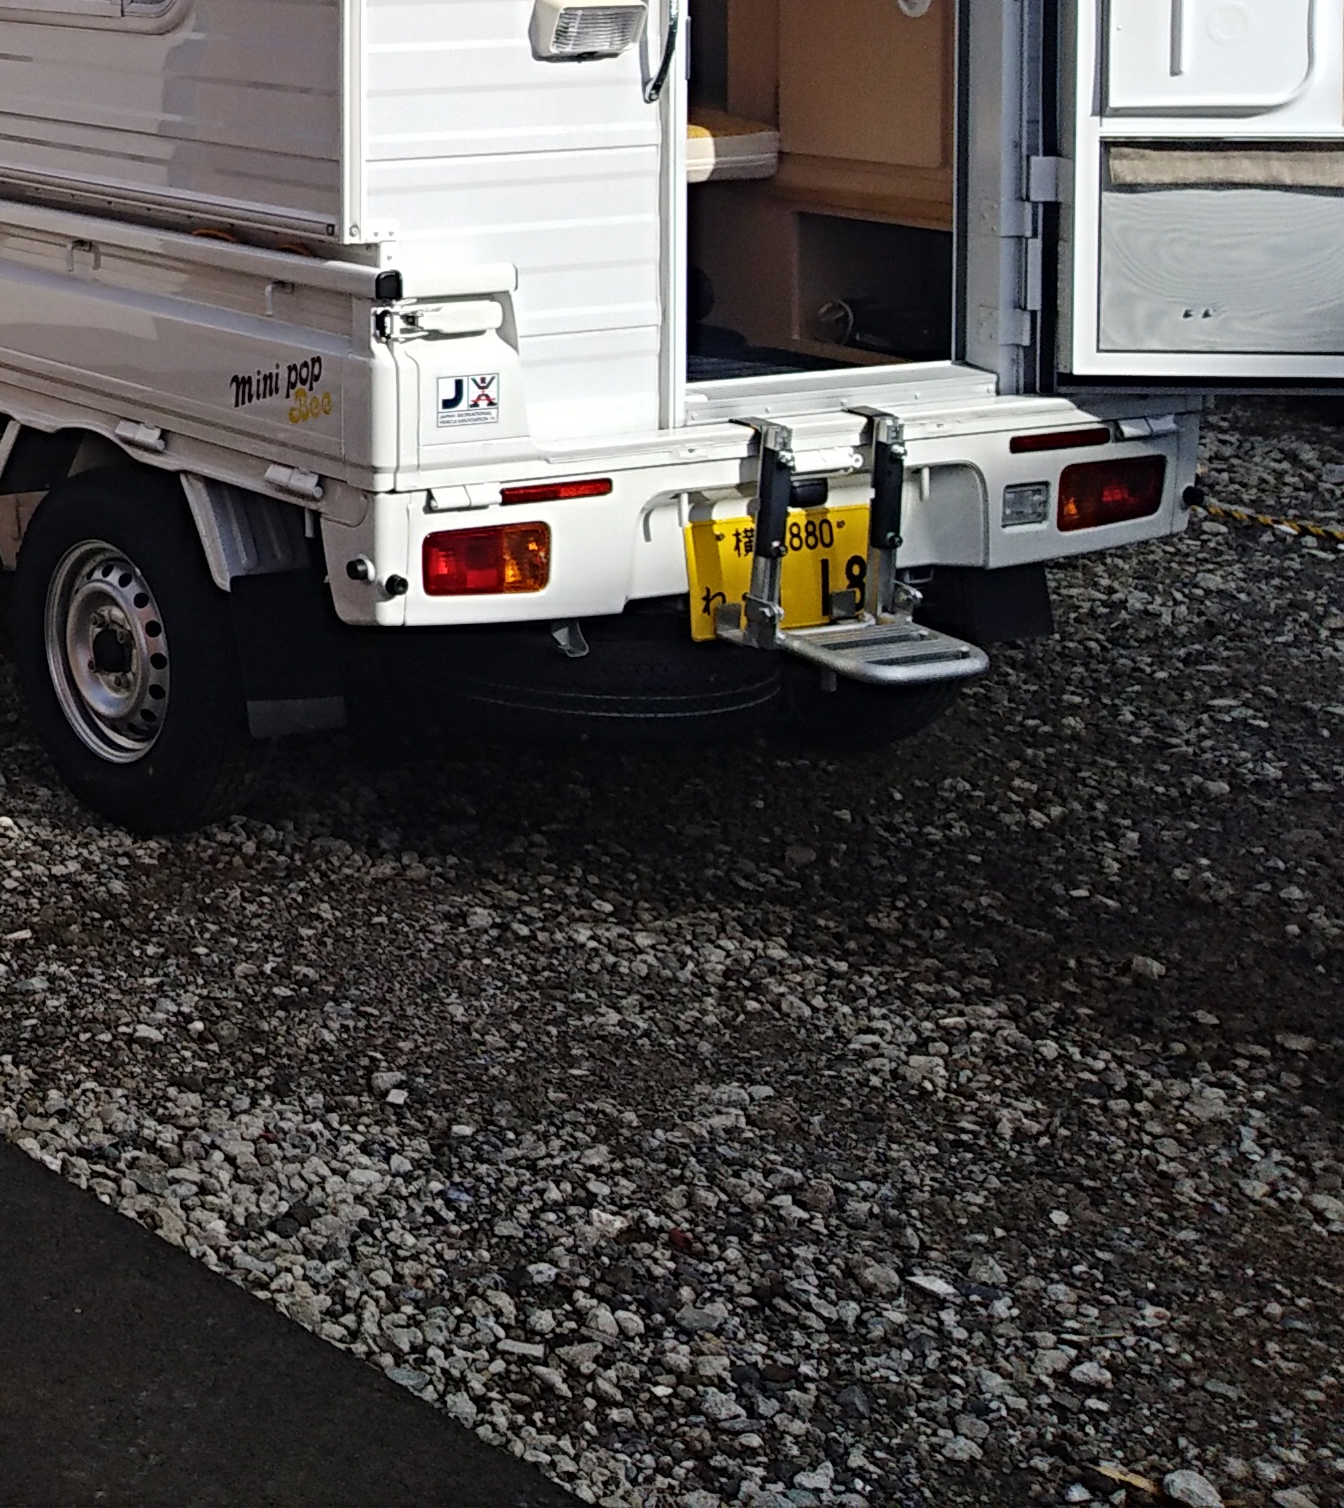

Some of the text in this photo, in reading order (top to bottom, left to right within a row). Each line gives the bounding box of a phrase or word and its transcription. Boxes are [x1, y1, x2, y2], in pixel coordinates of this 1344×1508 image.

[229, 355, 322, 408] mini pop
[732, 518, 833, 558] 横 880
